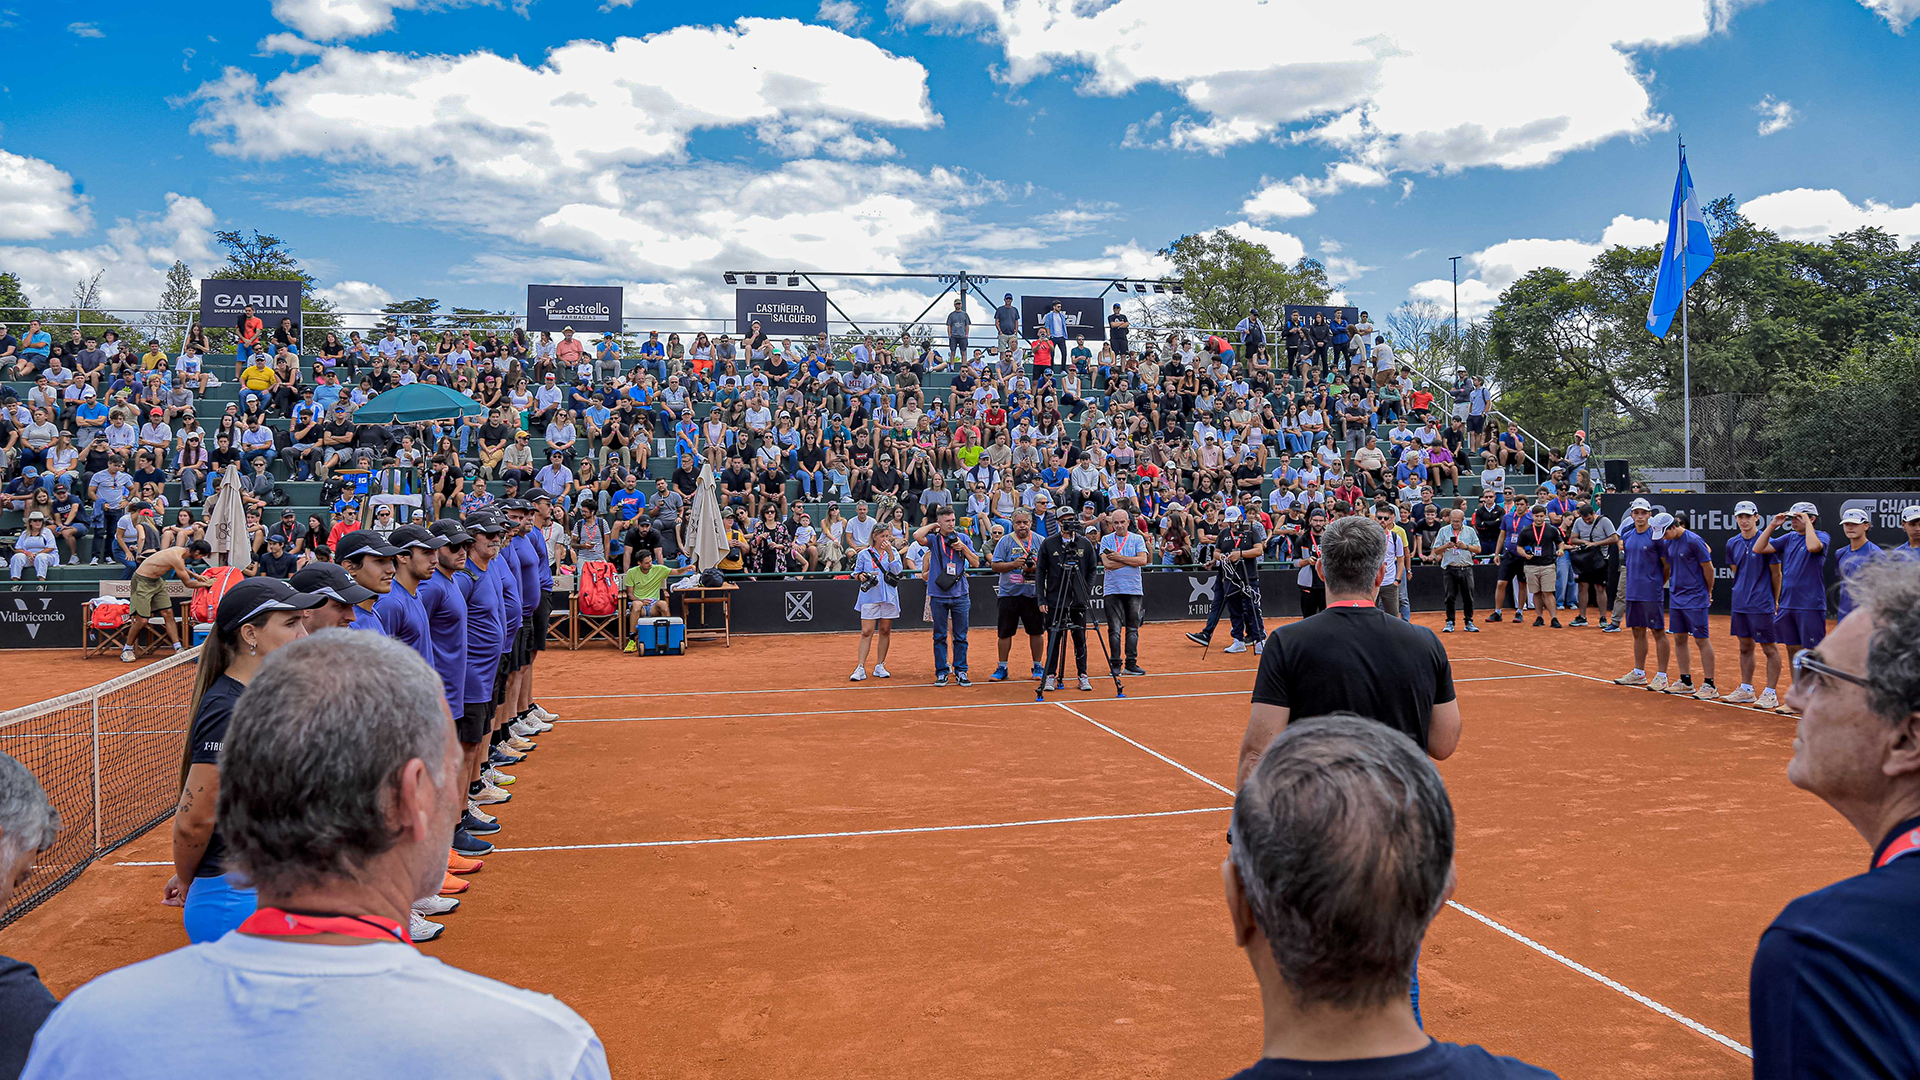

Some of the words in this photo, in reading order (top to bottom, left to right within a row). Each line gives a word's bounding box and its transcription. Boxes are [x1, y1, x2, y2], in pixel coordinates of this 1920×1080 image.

[213, 293, 288, 308] GARIN
[566, 302, 610, 315] estrella
[756, 302, 806, 314] CASTIÑEIRA
[772, 313, 817, 324] SALGUERO
[0, 610, 66, 623] Villavicencio
